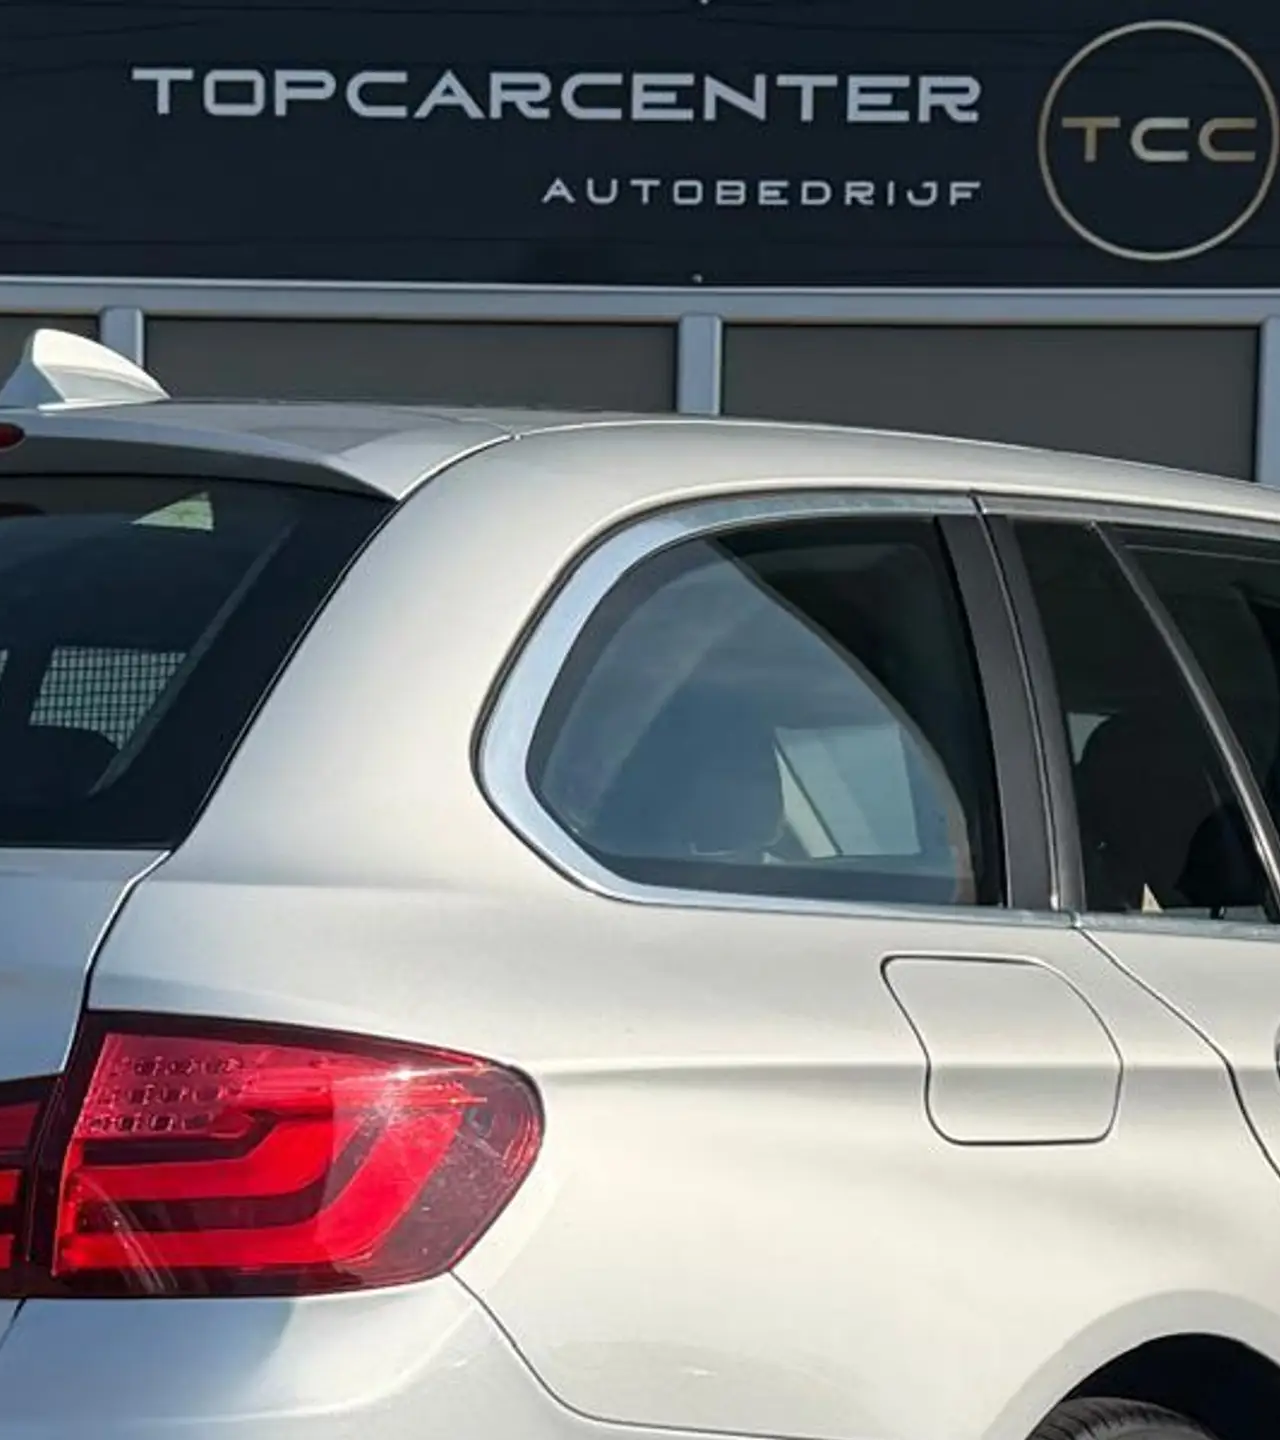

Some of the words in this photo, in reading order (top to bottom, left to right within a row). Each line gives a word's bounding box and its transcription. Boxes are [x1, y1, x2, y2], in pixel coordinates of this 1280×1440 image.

[131, 67, 982, 123] TOPCARCENTER
[1061, 116, 1258, 163] TCC
[541, 177, 982, 207] AUTOBEDRIJF
